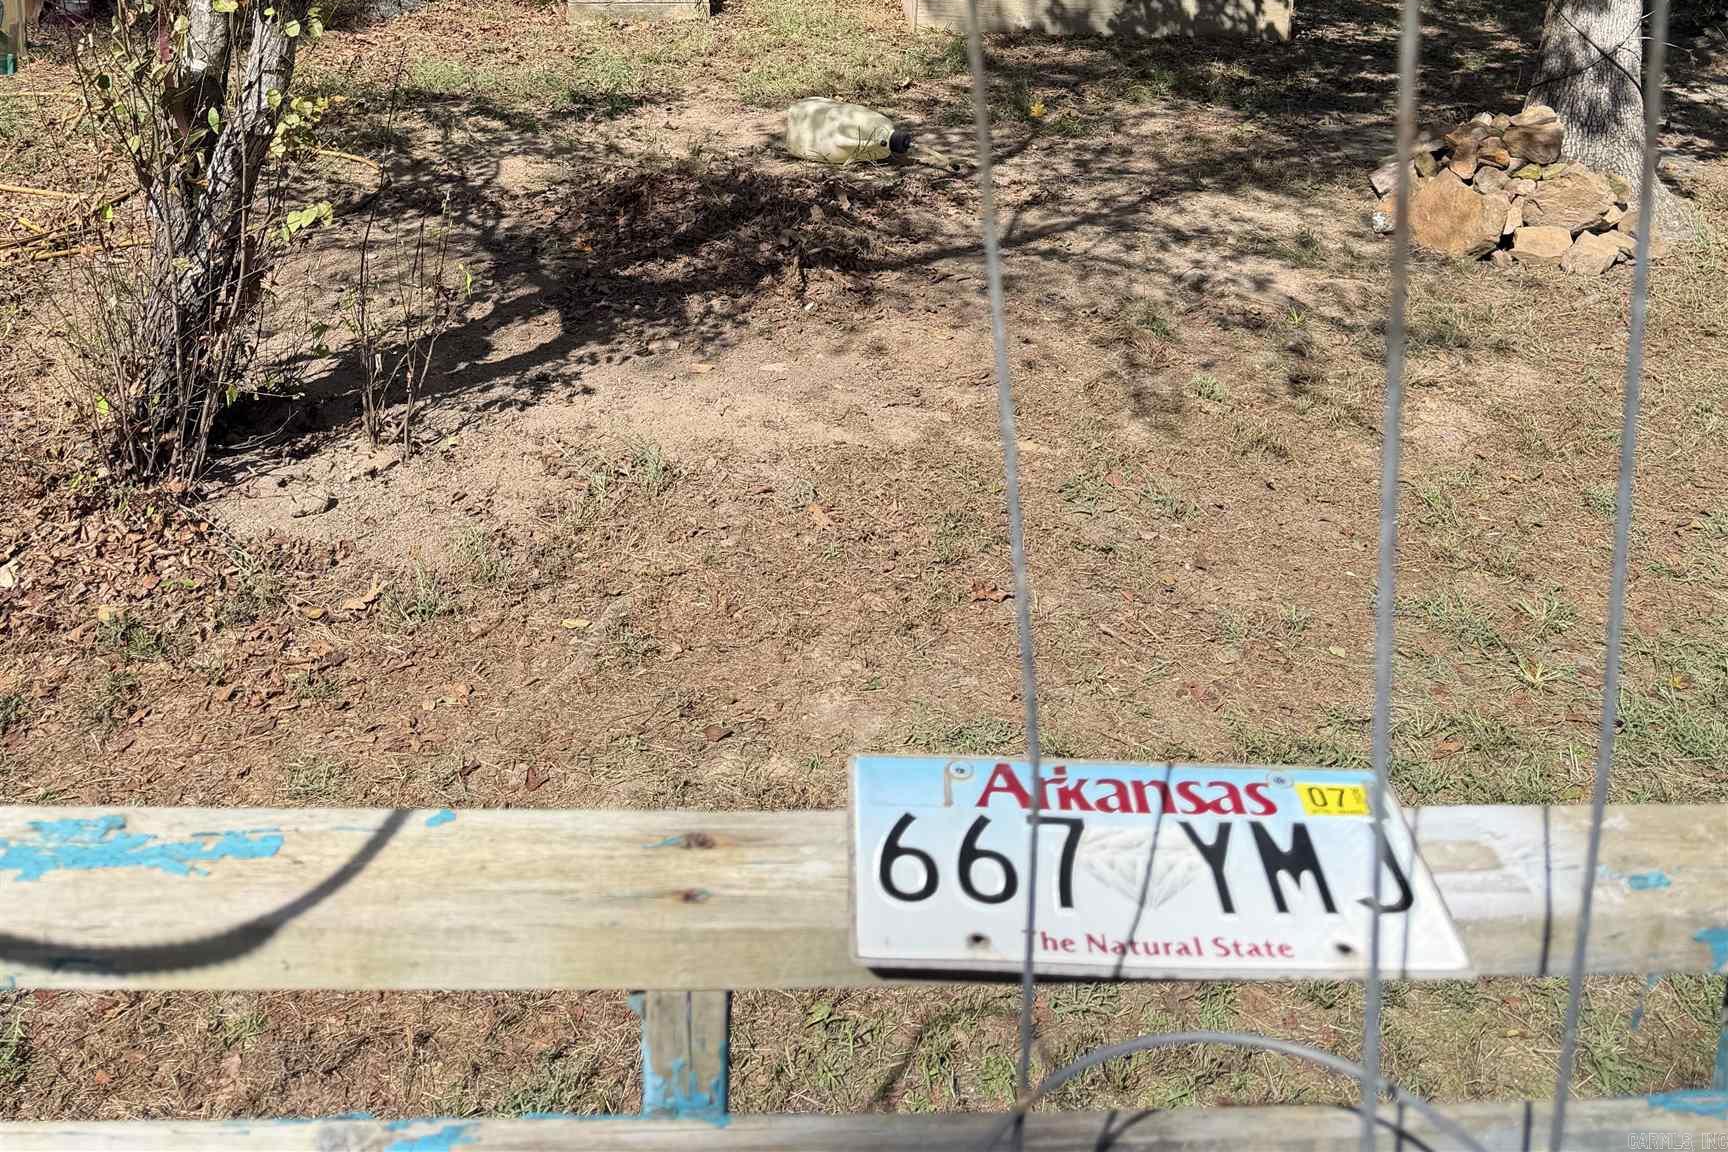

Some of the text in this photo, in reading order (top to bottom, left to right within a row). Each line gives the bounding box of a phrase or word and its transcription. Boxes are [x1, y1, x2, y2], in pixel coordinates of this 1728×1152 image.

[976, 762, 1279, 817] Arkansas
[1307, 786, 1345, 808] 07
[879, 811, 1415, 914] 667 YMJ
[1085, 932, 1204, 957] Natural
[1210, 935, 1296, 958] State
